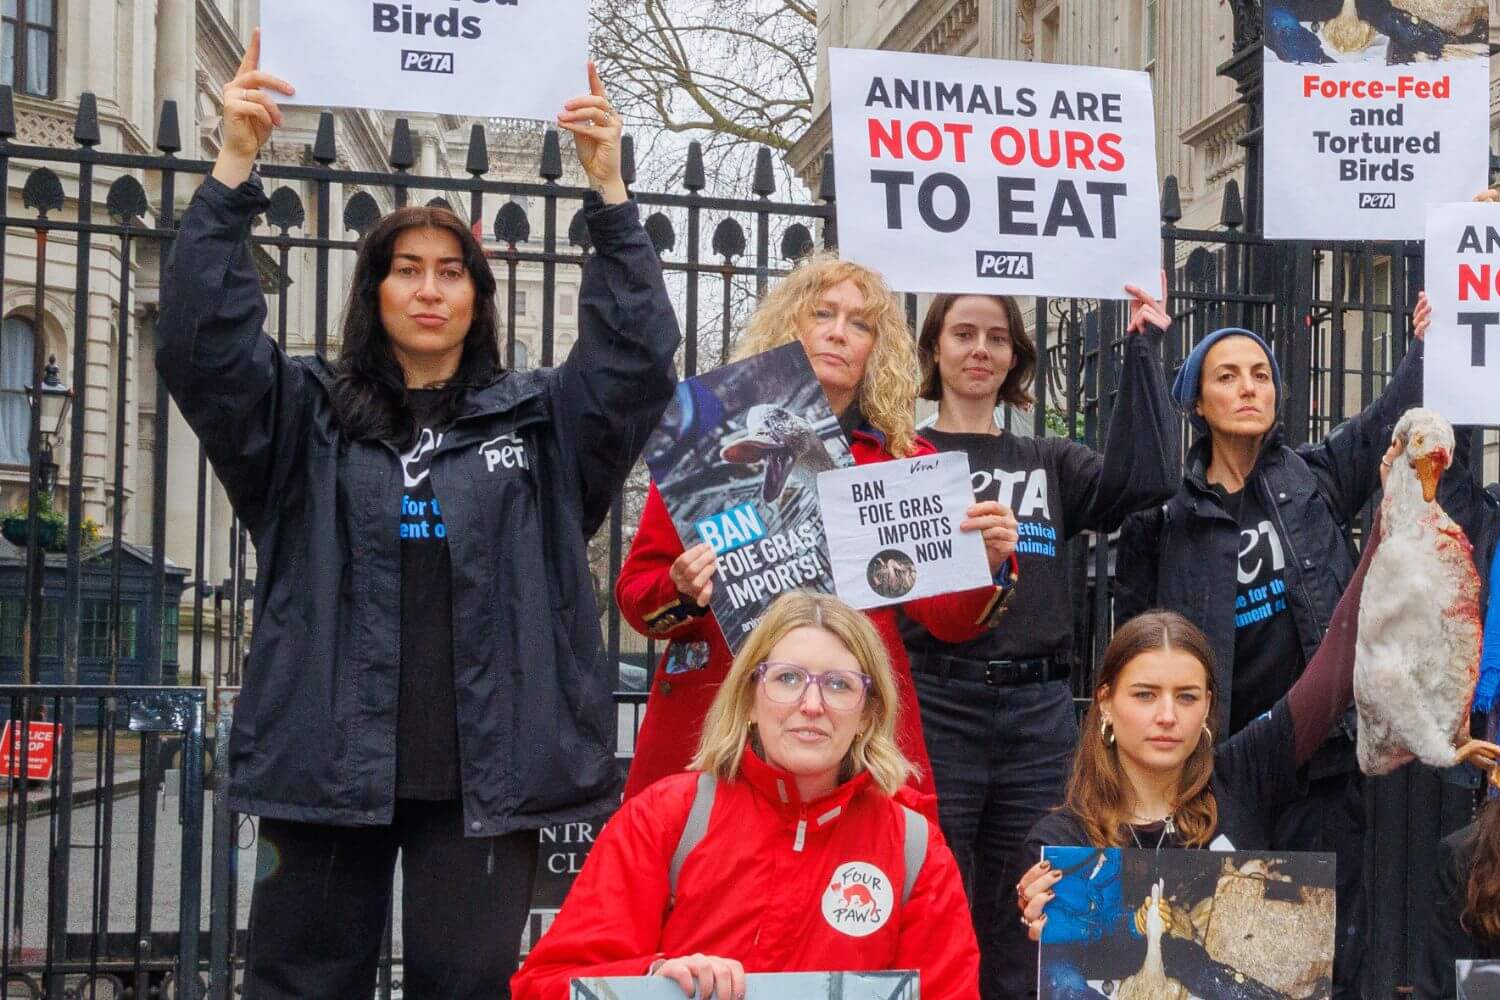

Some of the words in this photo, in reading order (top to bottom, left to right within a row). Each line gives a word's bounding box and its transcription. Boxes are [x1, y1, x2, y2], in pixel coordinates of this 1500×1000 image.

[373, 3, 481, 39] Birds
[1303, 75, 1450, 98] Force-Fed
[865, 76, 1037, 117] ANIMALS
[1050, 90, 1122, 123] ARE
[1350, 103, 1403, 126] and
[868, 118, 972, 162] NOT
[990, 126, 1125, 172] OURS
[1313, 131, 1440, 153] Tortured
[1339, 159, 1414, 181] Birds
[870, 169, 970, 233] TO
[997, 176, 1127, 239] EAT
[910, 460, 938, 474] Viva!
[852, 480, 885, 503] BAN
[859, 502, 895, 525] FOIE
[899, 495, 943, 518] GRAS
[699, 504, 762, 552] BAN
[878, 516, 951, 545] IMPORTS
[1018, 522, 1056, 540] Ethical
[716, 544, 762, 582] FOIE
[760, 520, 817, 563] GRAS
[915, 539, 952, 563] NOW
[726, 552, 824, 609] IMPORTS!
[842, 867, 881, 890] FOUR
[833, 909, 881, 923] PAWS
